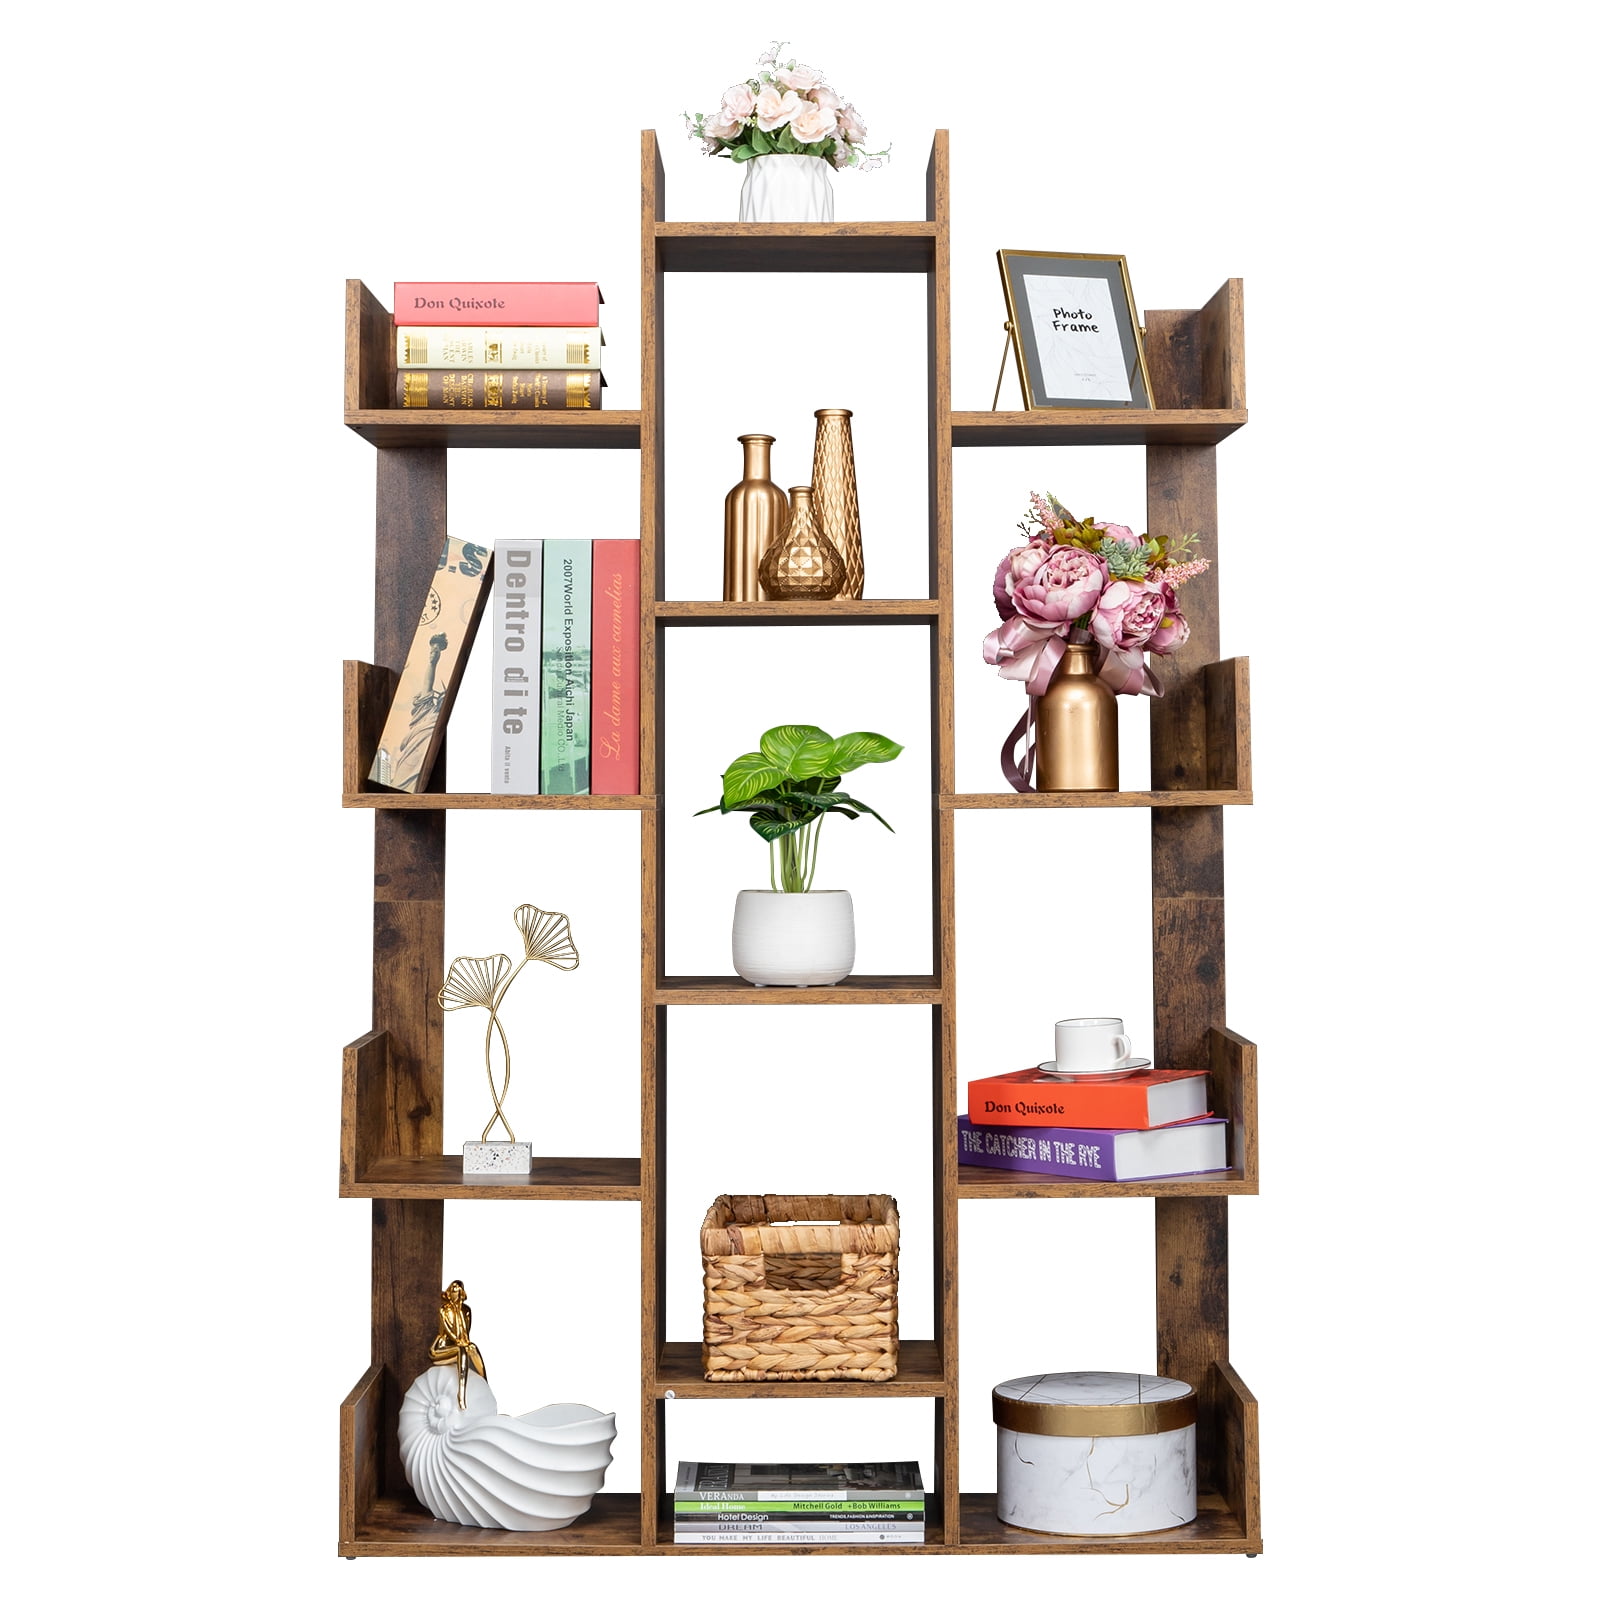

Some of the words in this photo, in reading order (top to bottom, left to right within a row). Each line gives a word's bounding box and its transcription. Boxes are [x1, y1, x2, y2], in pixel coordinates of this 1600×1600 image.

[414, 298, 444, 309] Don
[449, 298, 505, 311] Quixote
[1053, 307, 1092, 320] Photo
[1052, 320, 1100, 333] Frame
[505, 550, 531, 653] Dentro
[605, 573, 622, 642] camelias
[563, 618, 574, 676] Exposition
[612, 646, 621, 677] aux
[565, 678, 574, 706] Aichi
[604, 681, 621, 726] dame
[564, 709, 574, 742] Japan
[600, 731, 621, 761] La
[984, 1101, 1011, 1113] Don
[1015, 1101, 1065, 1116] Quixote
[961, 1130, 984, 1153] THE
[985, 1132, 1037, 1160] CATCHER
[1038, 1139, 1052, 1162] IN
[1053, 1141, 1076, 1165] THE
[1078, 1144, 1102, 1168] RYE
[700, 1502, 720, 1510] Ideal
[722, 1502, 745, 1510] Home
[741, 1513, 769, 1522] Design
